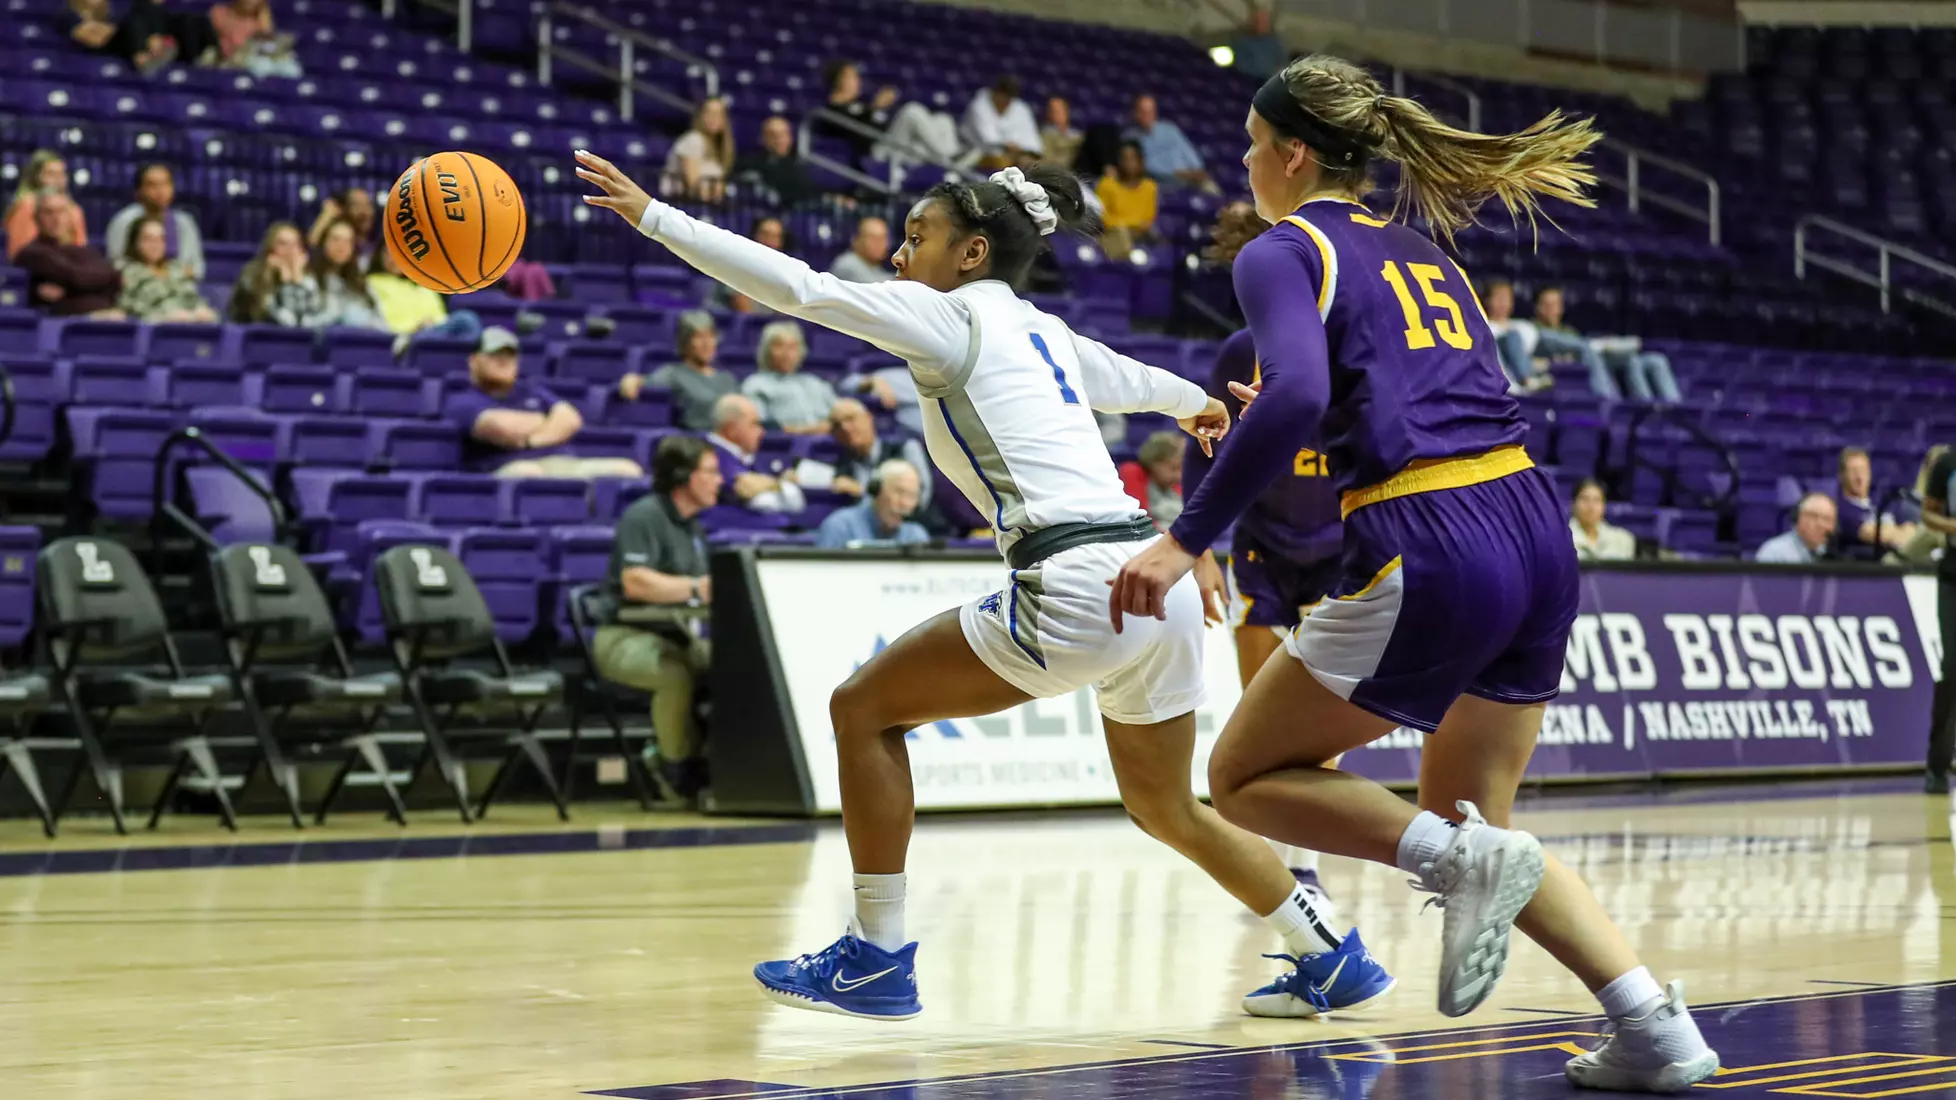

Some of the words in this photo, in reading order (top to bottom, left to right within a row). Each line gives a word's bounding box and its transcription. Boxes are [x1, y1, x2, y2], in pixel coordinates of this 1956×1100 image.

[396, 168, 430, 262] Wilson
[437, 173, 465, 221] EVO
[1380, 260, 1473, 350] 15
[1029, 332, 1081, 406] 1
[76, 542, 114, 582] L
[249, 546, 286, 585] L
[410, 548, 447, 587] L
[1559, 612, 1657, 692] MB
[1663, 614, 1912, 690] BISONS
[1538, 703, 1613, 744] ENA
[1638, 700, 1829, 743] NASHVILLE,
[1826, 700, 1874, 738] TN
